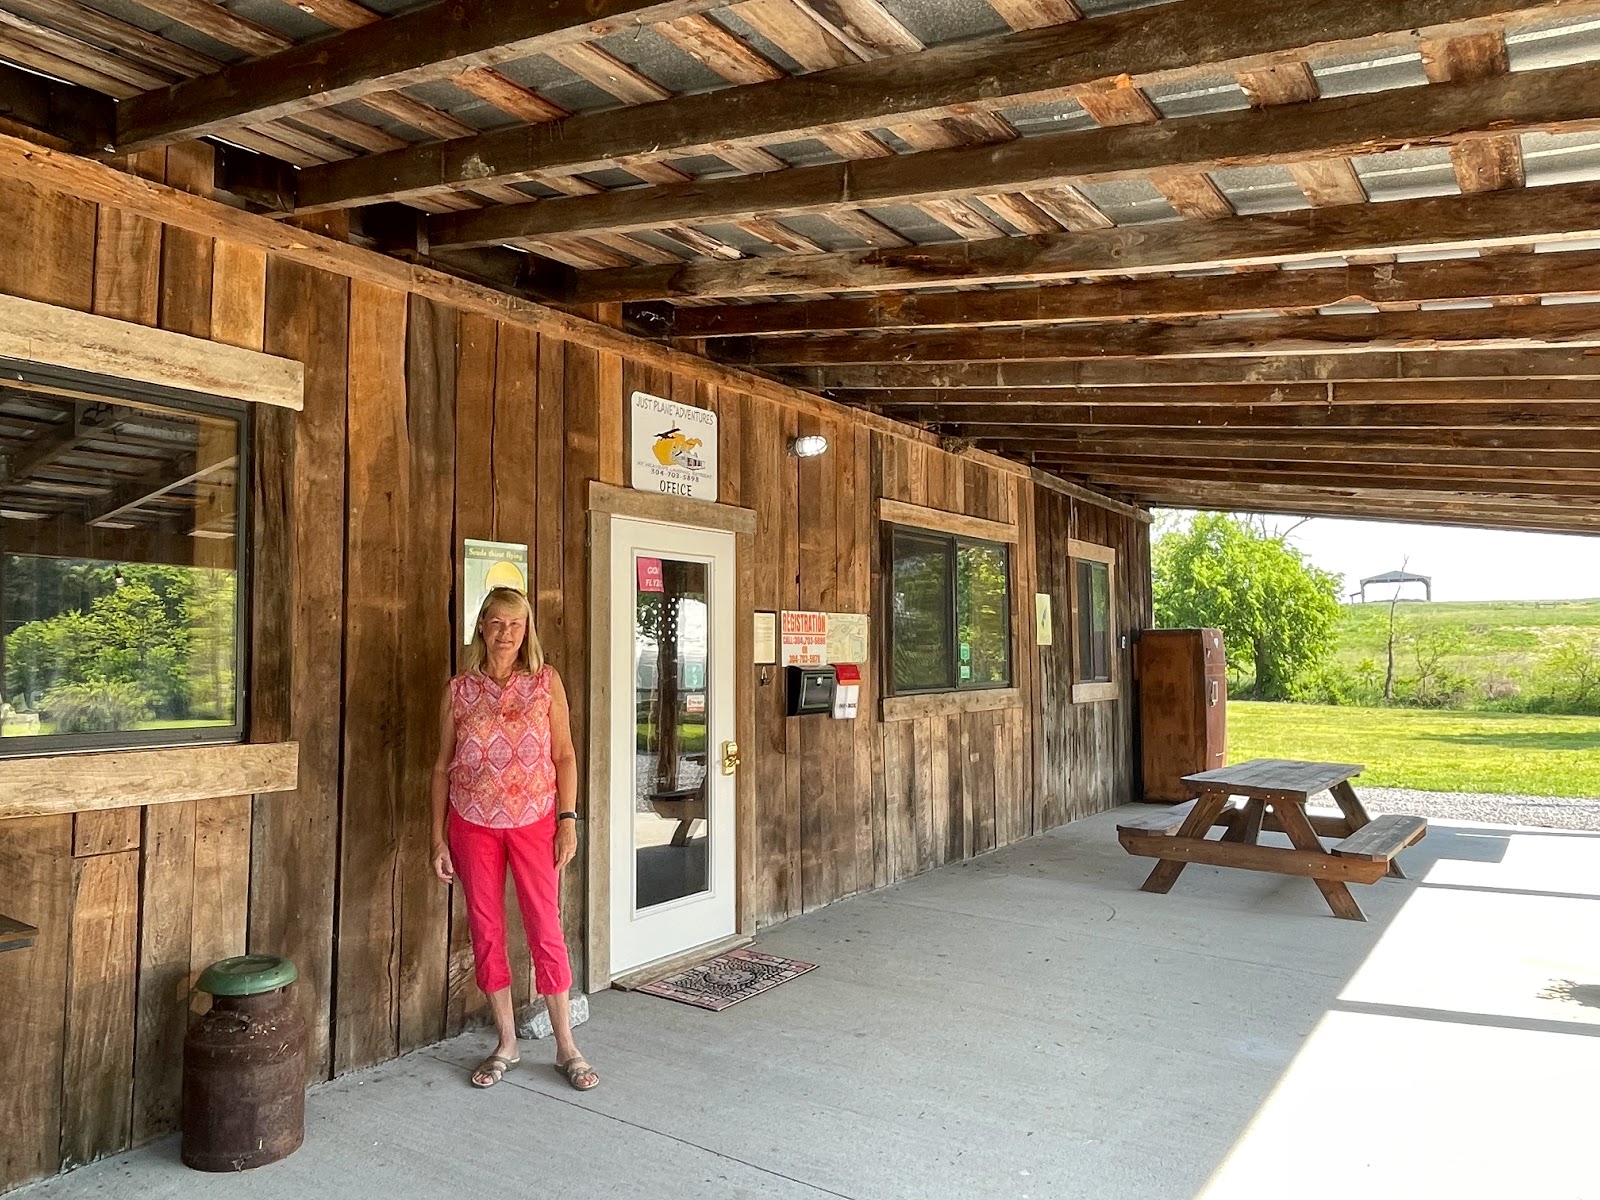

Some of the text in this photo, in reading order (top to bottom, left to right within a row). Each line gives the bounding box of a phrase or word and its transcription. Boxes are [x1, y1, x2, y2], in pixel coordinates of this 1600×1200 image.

[636, 397, 652, 410] JUST
[675, 405, 713, 426] ADVENTURES
[660, 479, 692, 497] OFFICE
[782, 612, 826, 633] REGISTRATION
